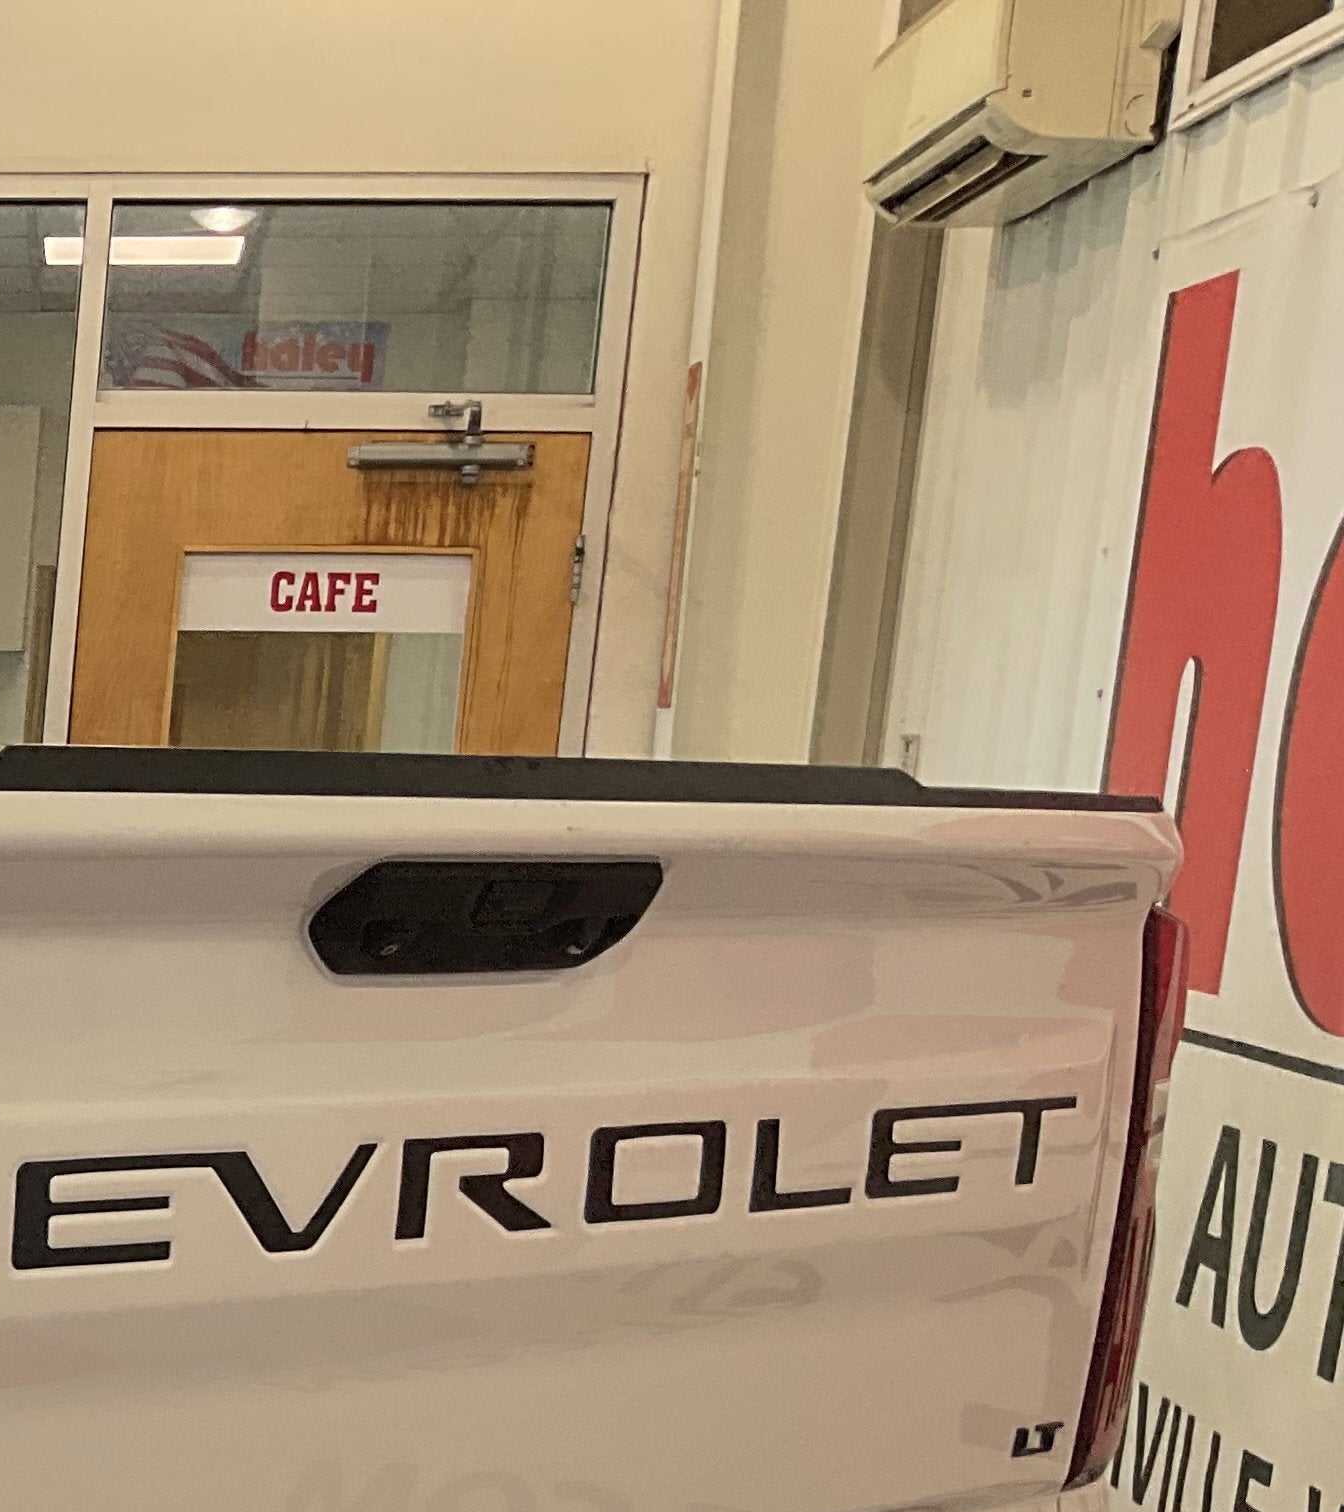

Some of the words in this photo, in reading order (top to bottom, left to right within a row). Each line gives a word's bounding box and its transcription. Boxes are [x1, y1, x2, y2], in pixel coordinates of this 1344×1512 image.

[241, 330, 376, 383] haley
[269, 570, 380, 613] CAFE
[1011, 1421, 1065, 1458] LT
